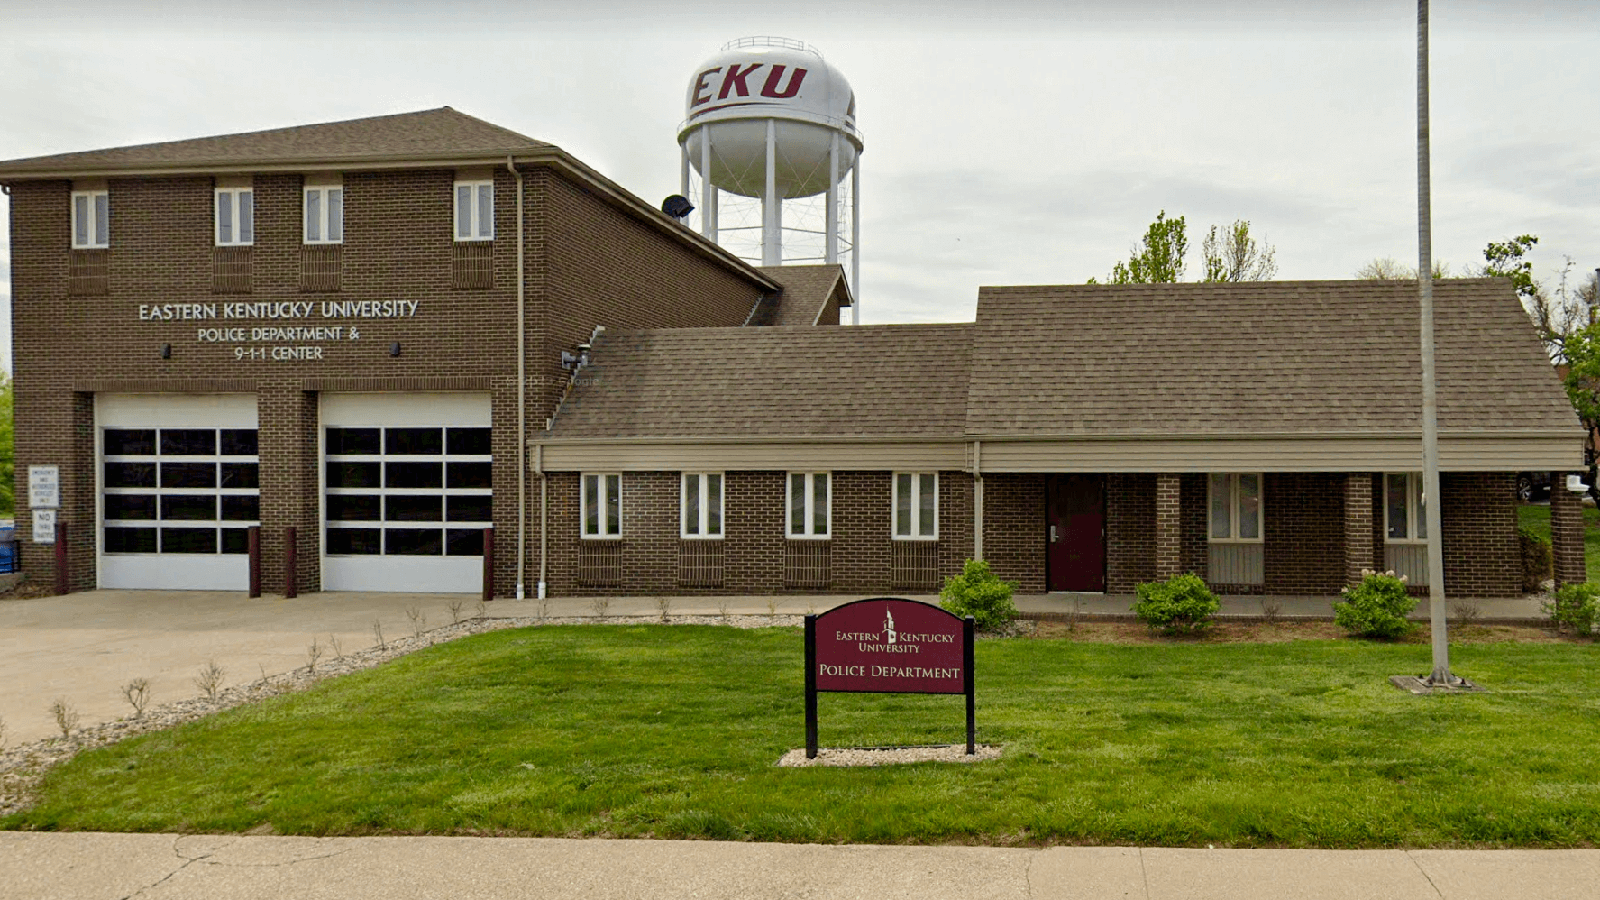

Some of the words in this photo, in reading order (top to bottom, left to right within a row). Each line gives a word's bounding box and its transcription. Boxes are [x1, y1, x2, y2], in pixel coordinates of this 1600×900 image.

[690, 63, 808, 109] EKU
[139, 303, 216, 320] EASTERN
[223, 301, 314, 319] KENTUCKY
[321, 300, 419, 318] UNIVERSITY
[198, 328, 245, 342] POLICE
[251, 326, 342, 341] DEPARTMENT
[349, 326, 360, 340] &
[234, 347, 266, 360] 9-1-1
[271, 347, 323, 360] CENTER
[836, 631, 880, 641] EASTERN
[899, 632, 955, 643] KENTUCKY
[858, 642, 920, 653] UNIVERSITY
[819, 664, 865, 676] POLICE
[871, 665, 960, 679] DEPARTMENT
